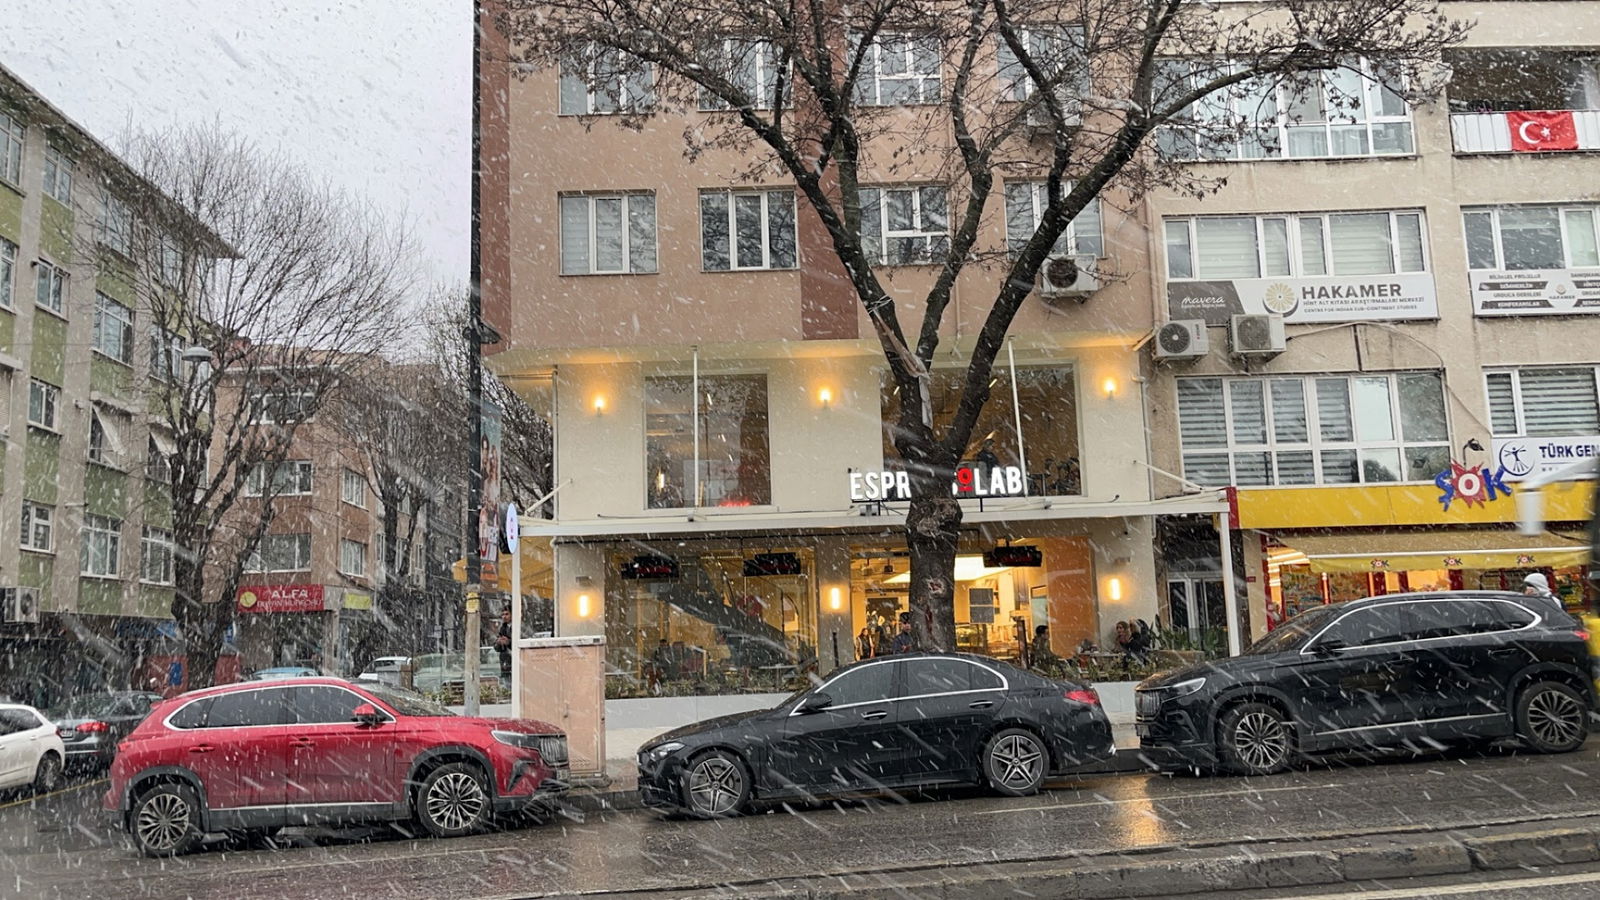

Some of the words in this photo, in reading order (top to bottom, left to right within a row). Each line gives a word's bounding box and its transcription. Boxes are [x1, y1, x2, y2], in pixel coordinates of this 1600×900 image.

[1301, 283, 1402, 299] HAKAMER
[1181, 295, 1226, 305] mavera
[1539, 443, 1574, 458] TÜRK
[850, 466, 1023, 500] ESPROLAB
[271, 589, 309, 599] ALFA
